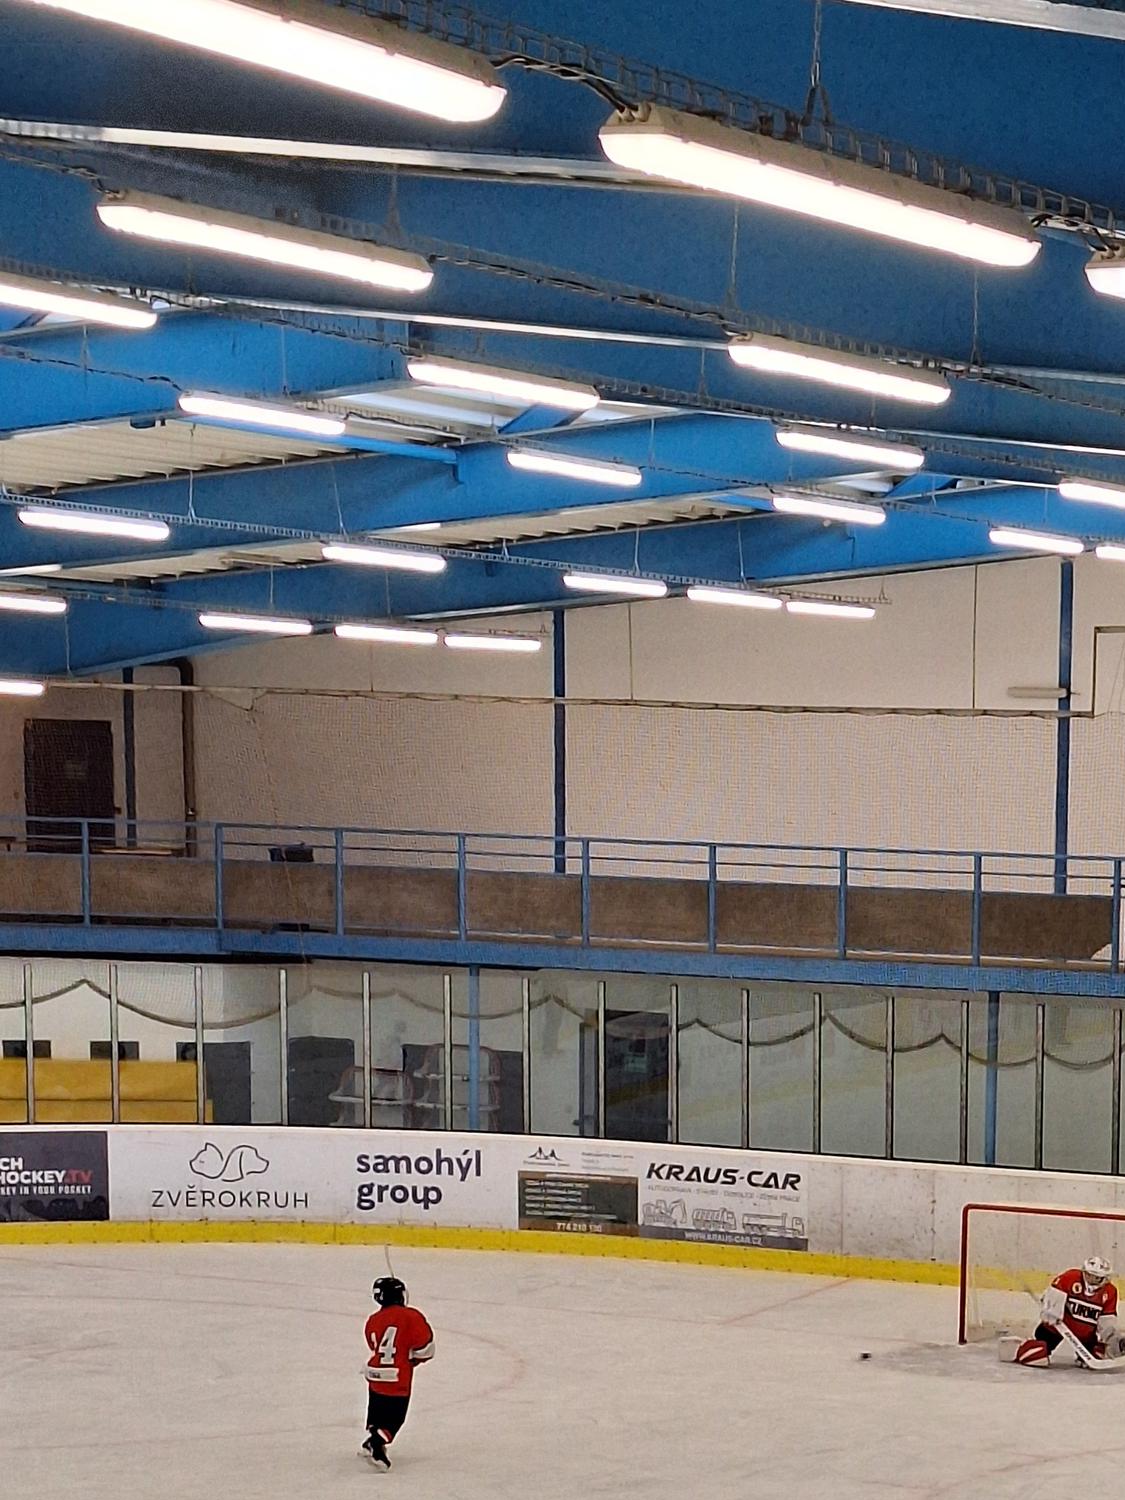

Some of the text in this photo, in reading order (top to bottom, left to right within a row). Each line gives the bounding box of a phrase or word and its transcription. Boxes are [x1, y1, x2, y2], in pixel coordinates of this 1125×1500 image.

[356, 1148, 481, 1182] samohýl
[646, 1163, 801, 1191] KRAUS-CAR
[151, 1184, 309, 1208] ZVĚROKRUH
[356, 1182, 443, 1210] group
